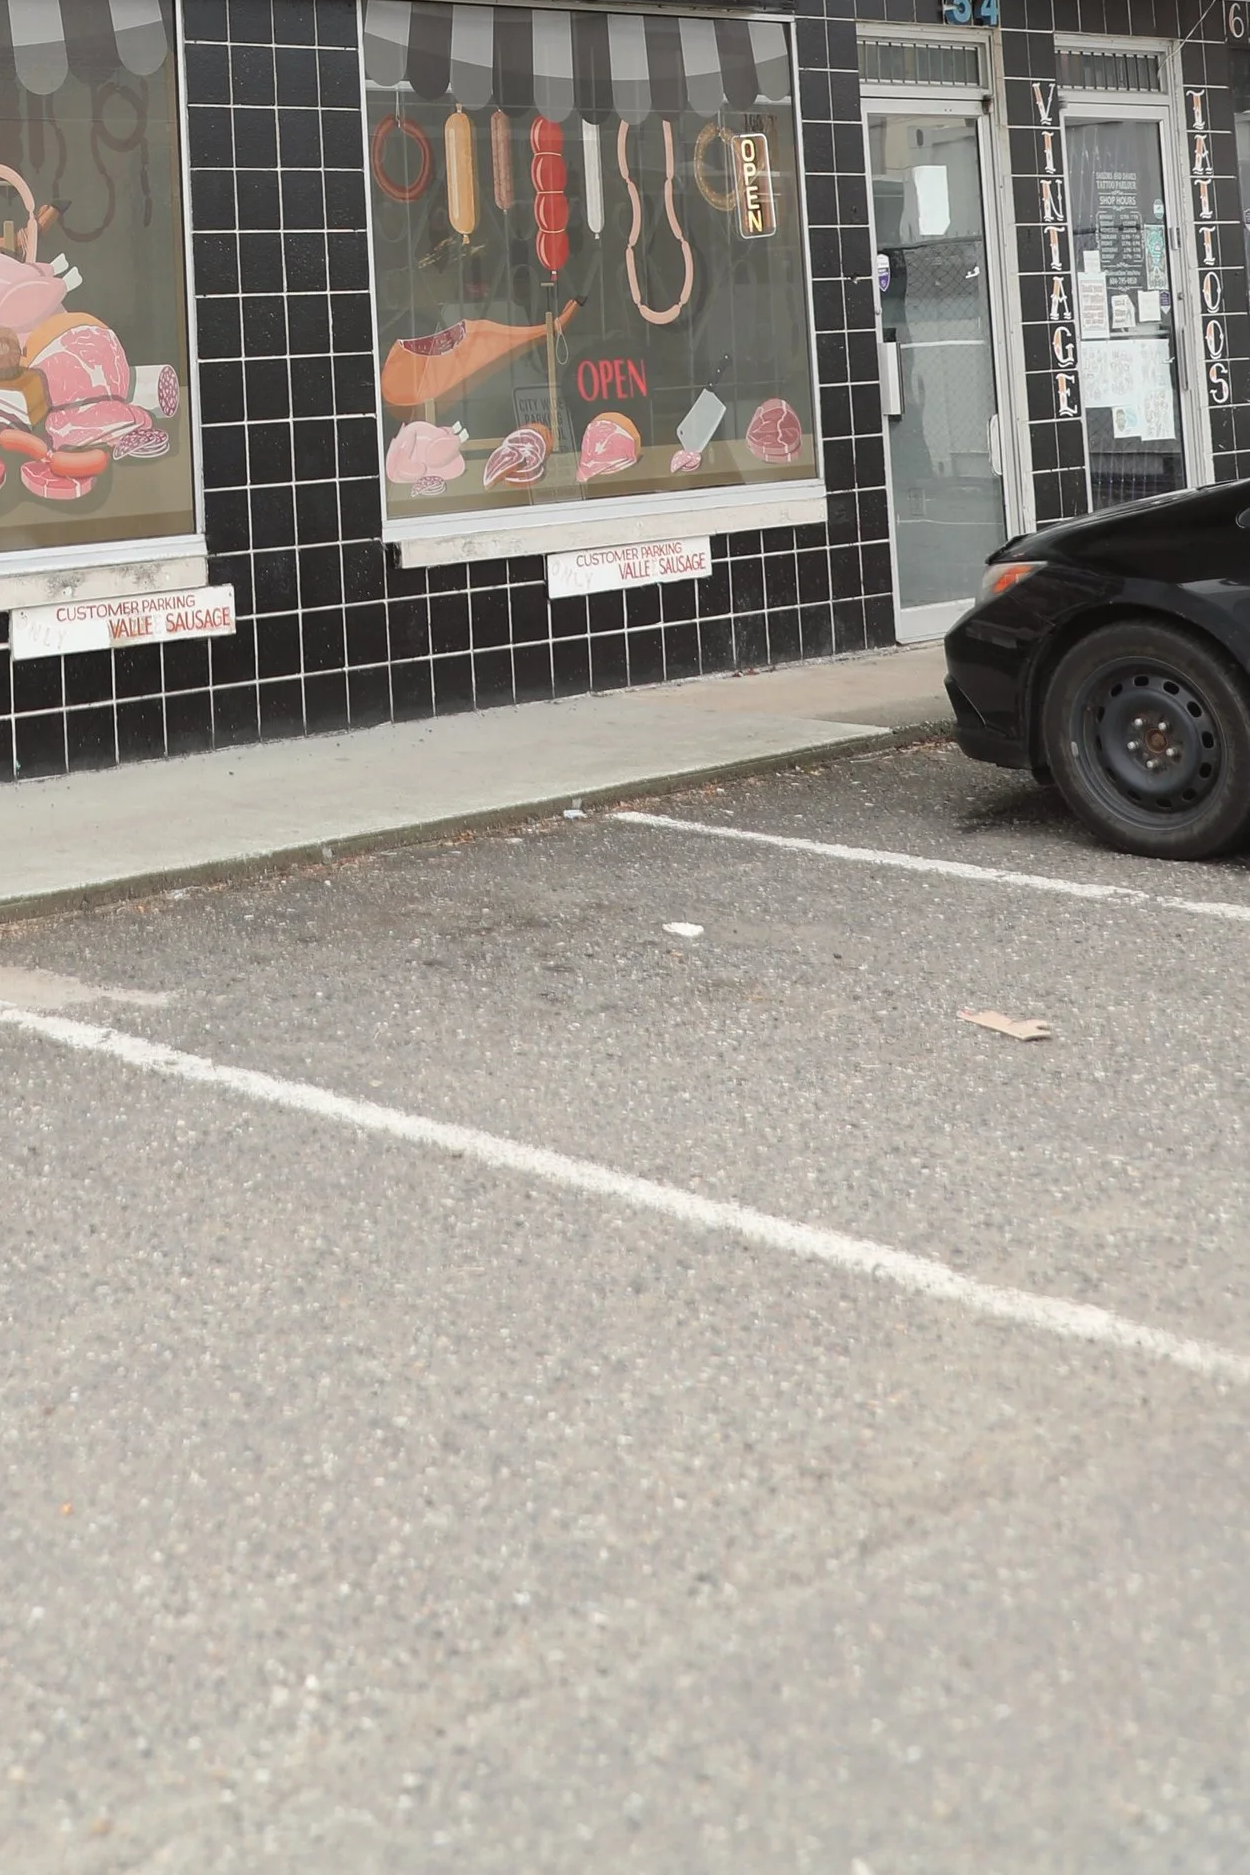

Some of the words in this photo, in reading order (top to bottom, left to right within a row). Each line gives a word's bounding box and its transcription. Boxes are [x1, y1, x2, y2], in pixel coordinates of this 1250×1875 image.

[740, 138, 764, 233] OPEN
[1099, 195, 1116, 206] SHOP
[1116, 196, 1137, 206] HOURS
[1031, 81, 1078, 418] VINTAGE
[1186, 88, 1230, 404] TATTOOS
[577, 357, 648, 402] OPEN
[519, 398, 540, 412] CITY
[576, 546, 639, 568] CUSTOMER
[641, 541, 683, 560] PARKING
[618, 559, 650, 581] VALLE
[659, 552, 707, 575] SAUSAGE
[56, 600, 139, 623] CUSTOMER
[141, 593, 196, 613] PARKING
[108, 614, 153, 639] VALLE
[165, 605, 232, 633] SAUSAGE
